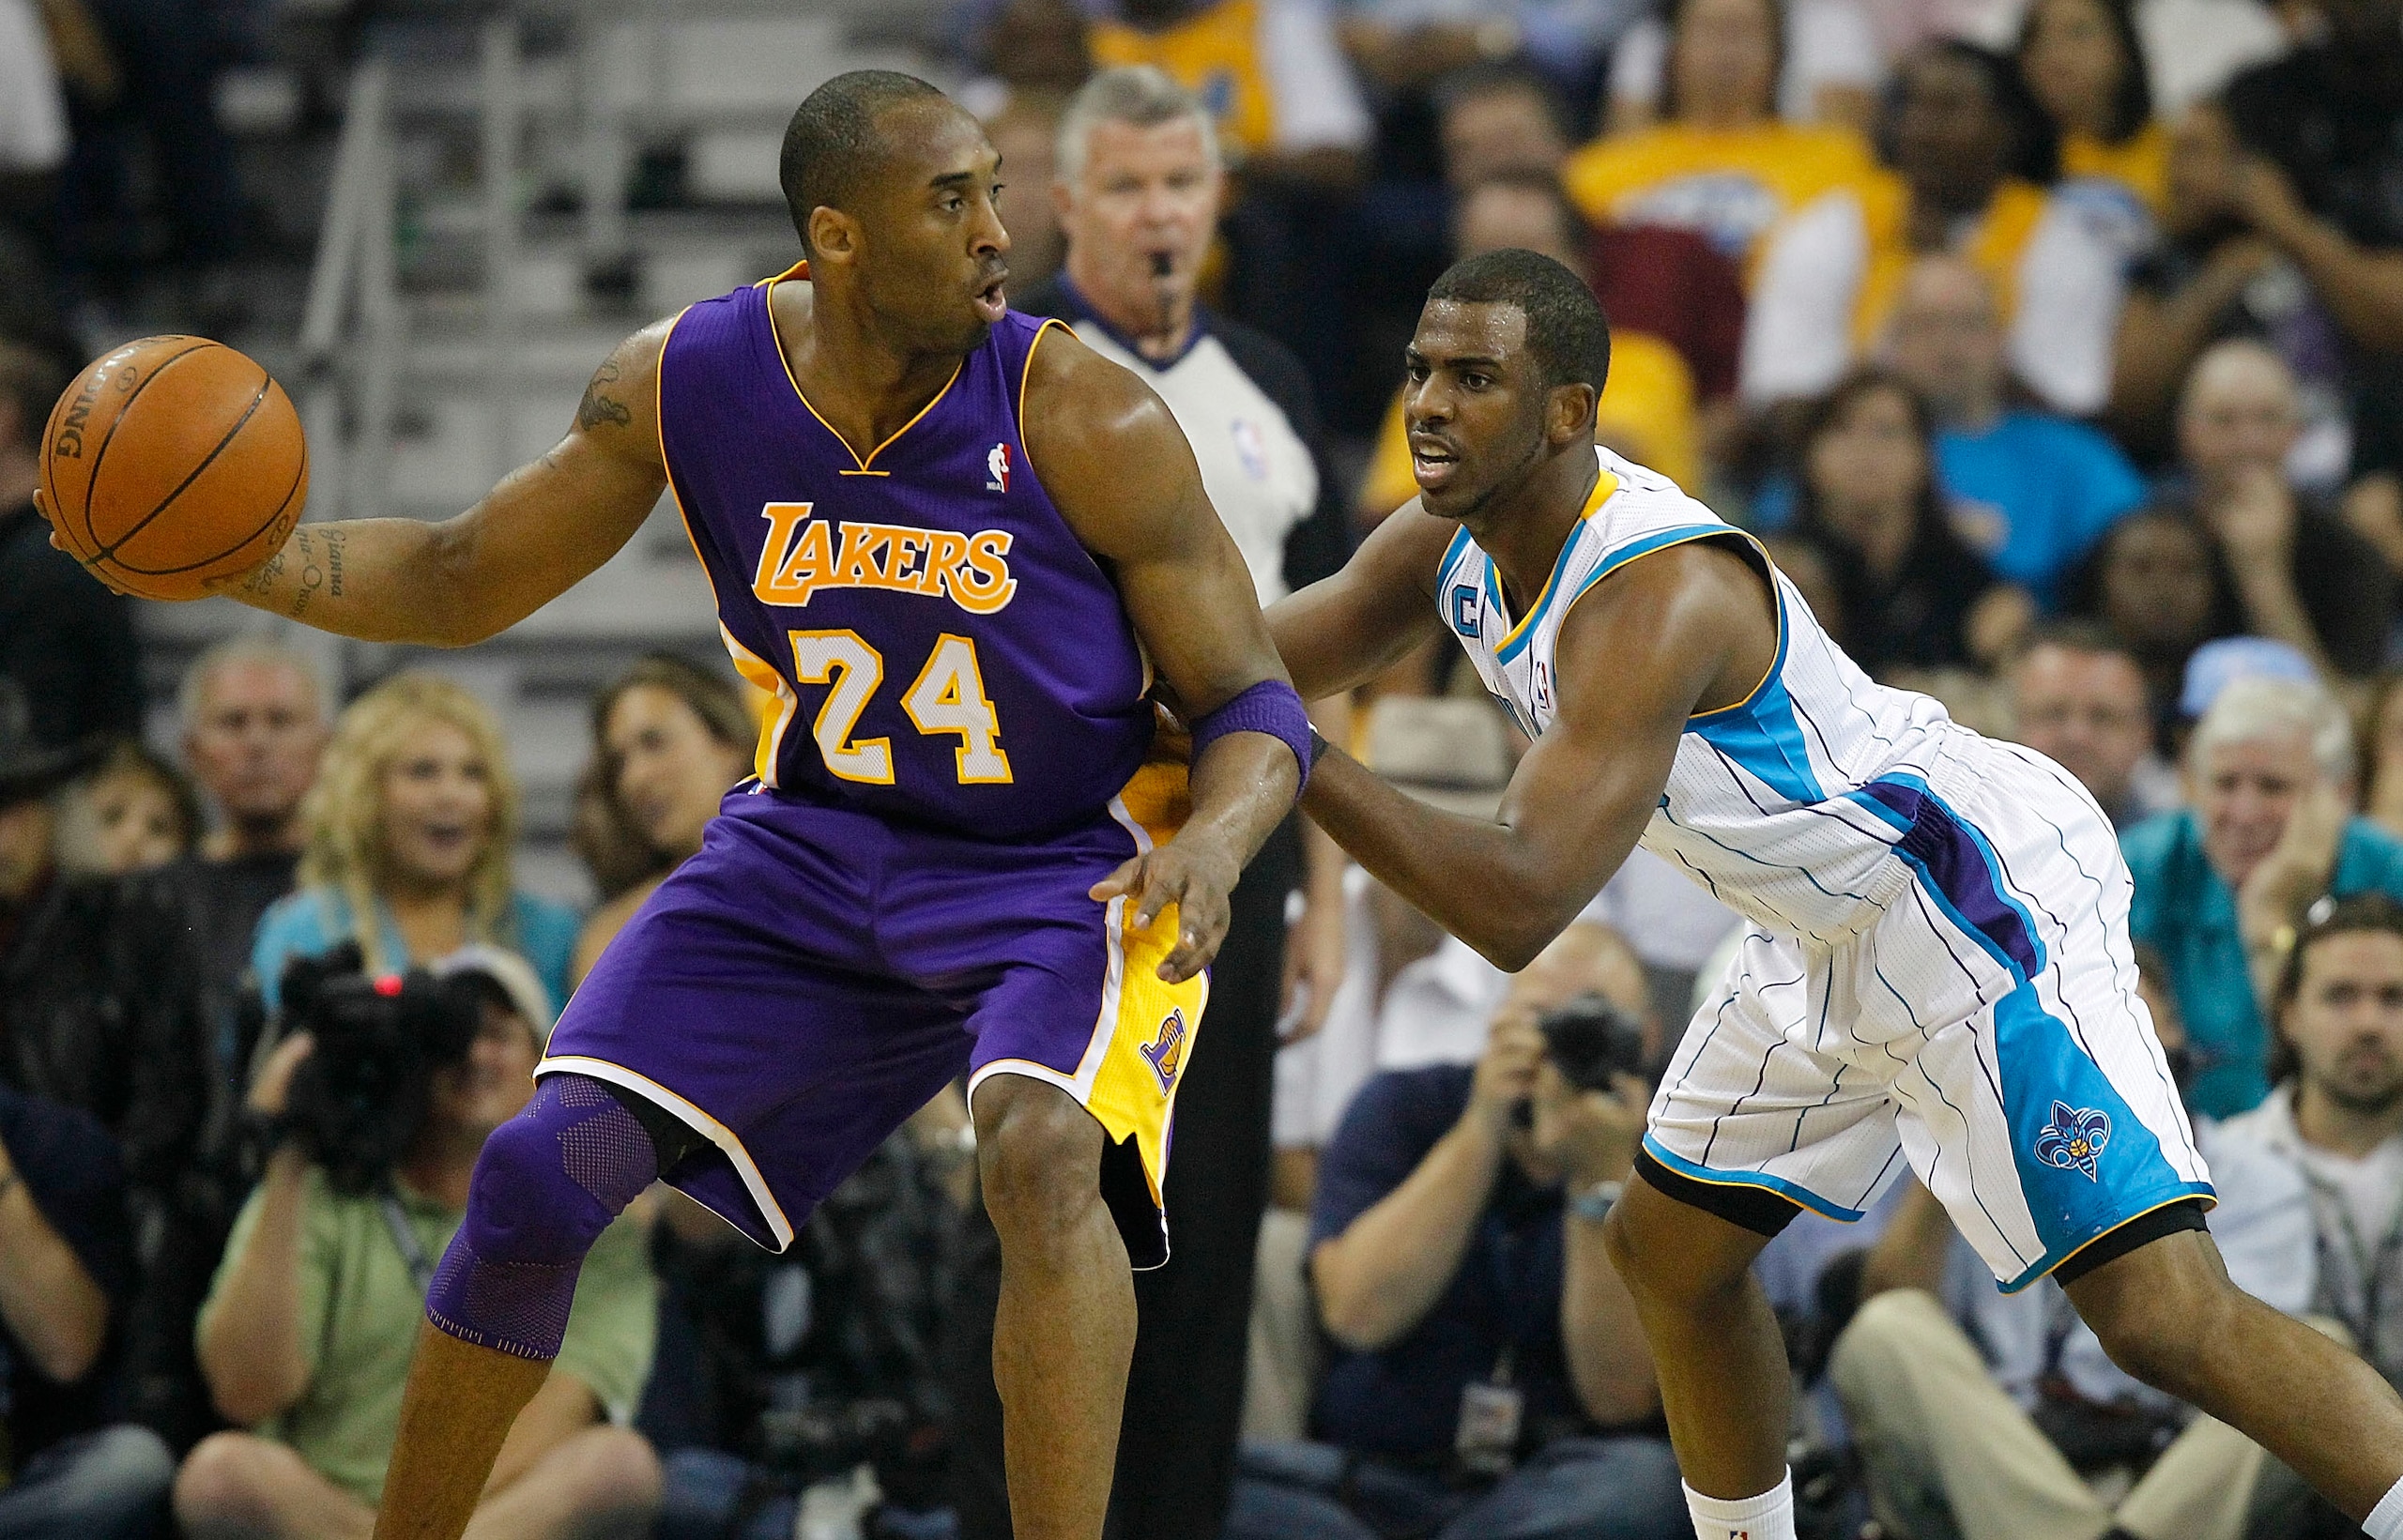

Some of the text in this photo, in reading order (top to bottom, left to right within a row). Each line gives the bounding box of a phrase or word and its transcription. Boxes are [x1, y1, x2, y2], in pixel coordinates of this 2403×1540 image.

[318, 528, 345, 596] Gianna
[751, 502, 1018, 615] LAKERS
[1452, 585, 1479, 638] C
[788, 629, 1014, 785] 24
